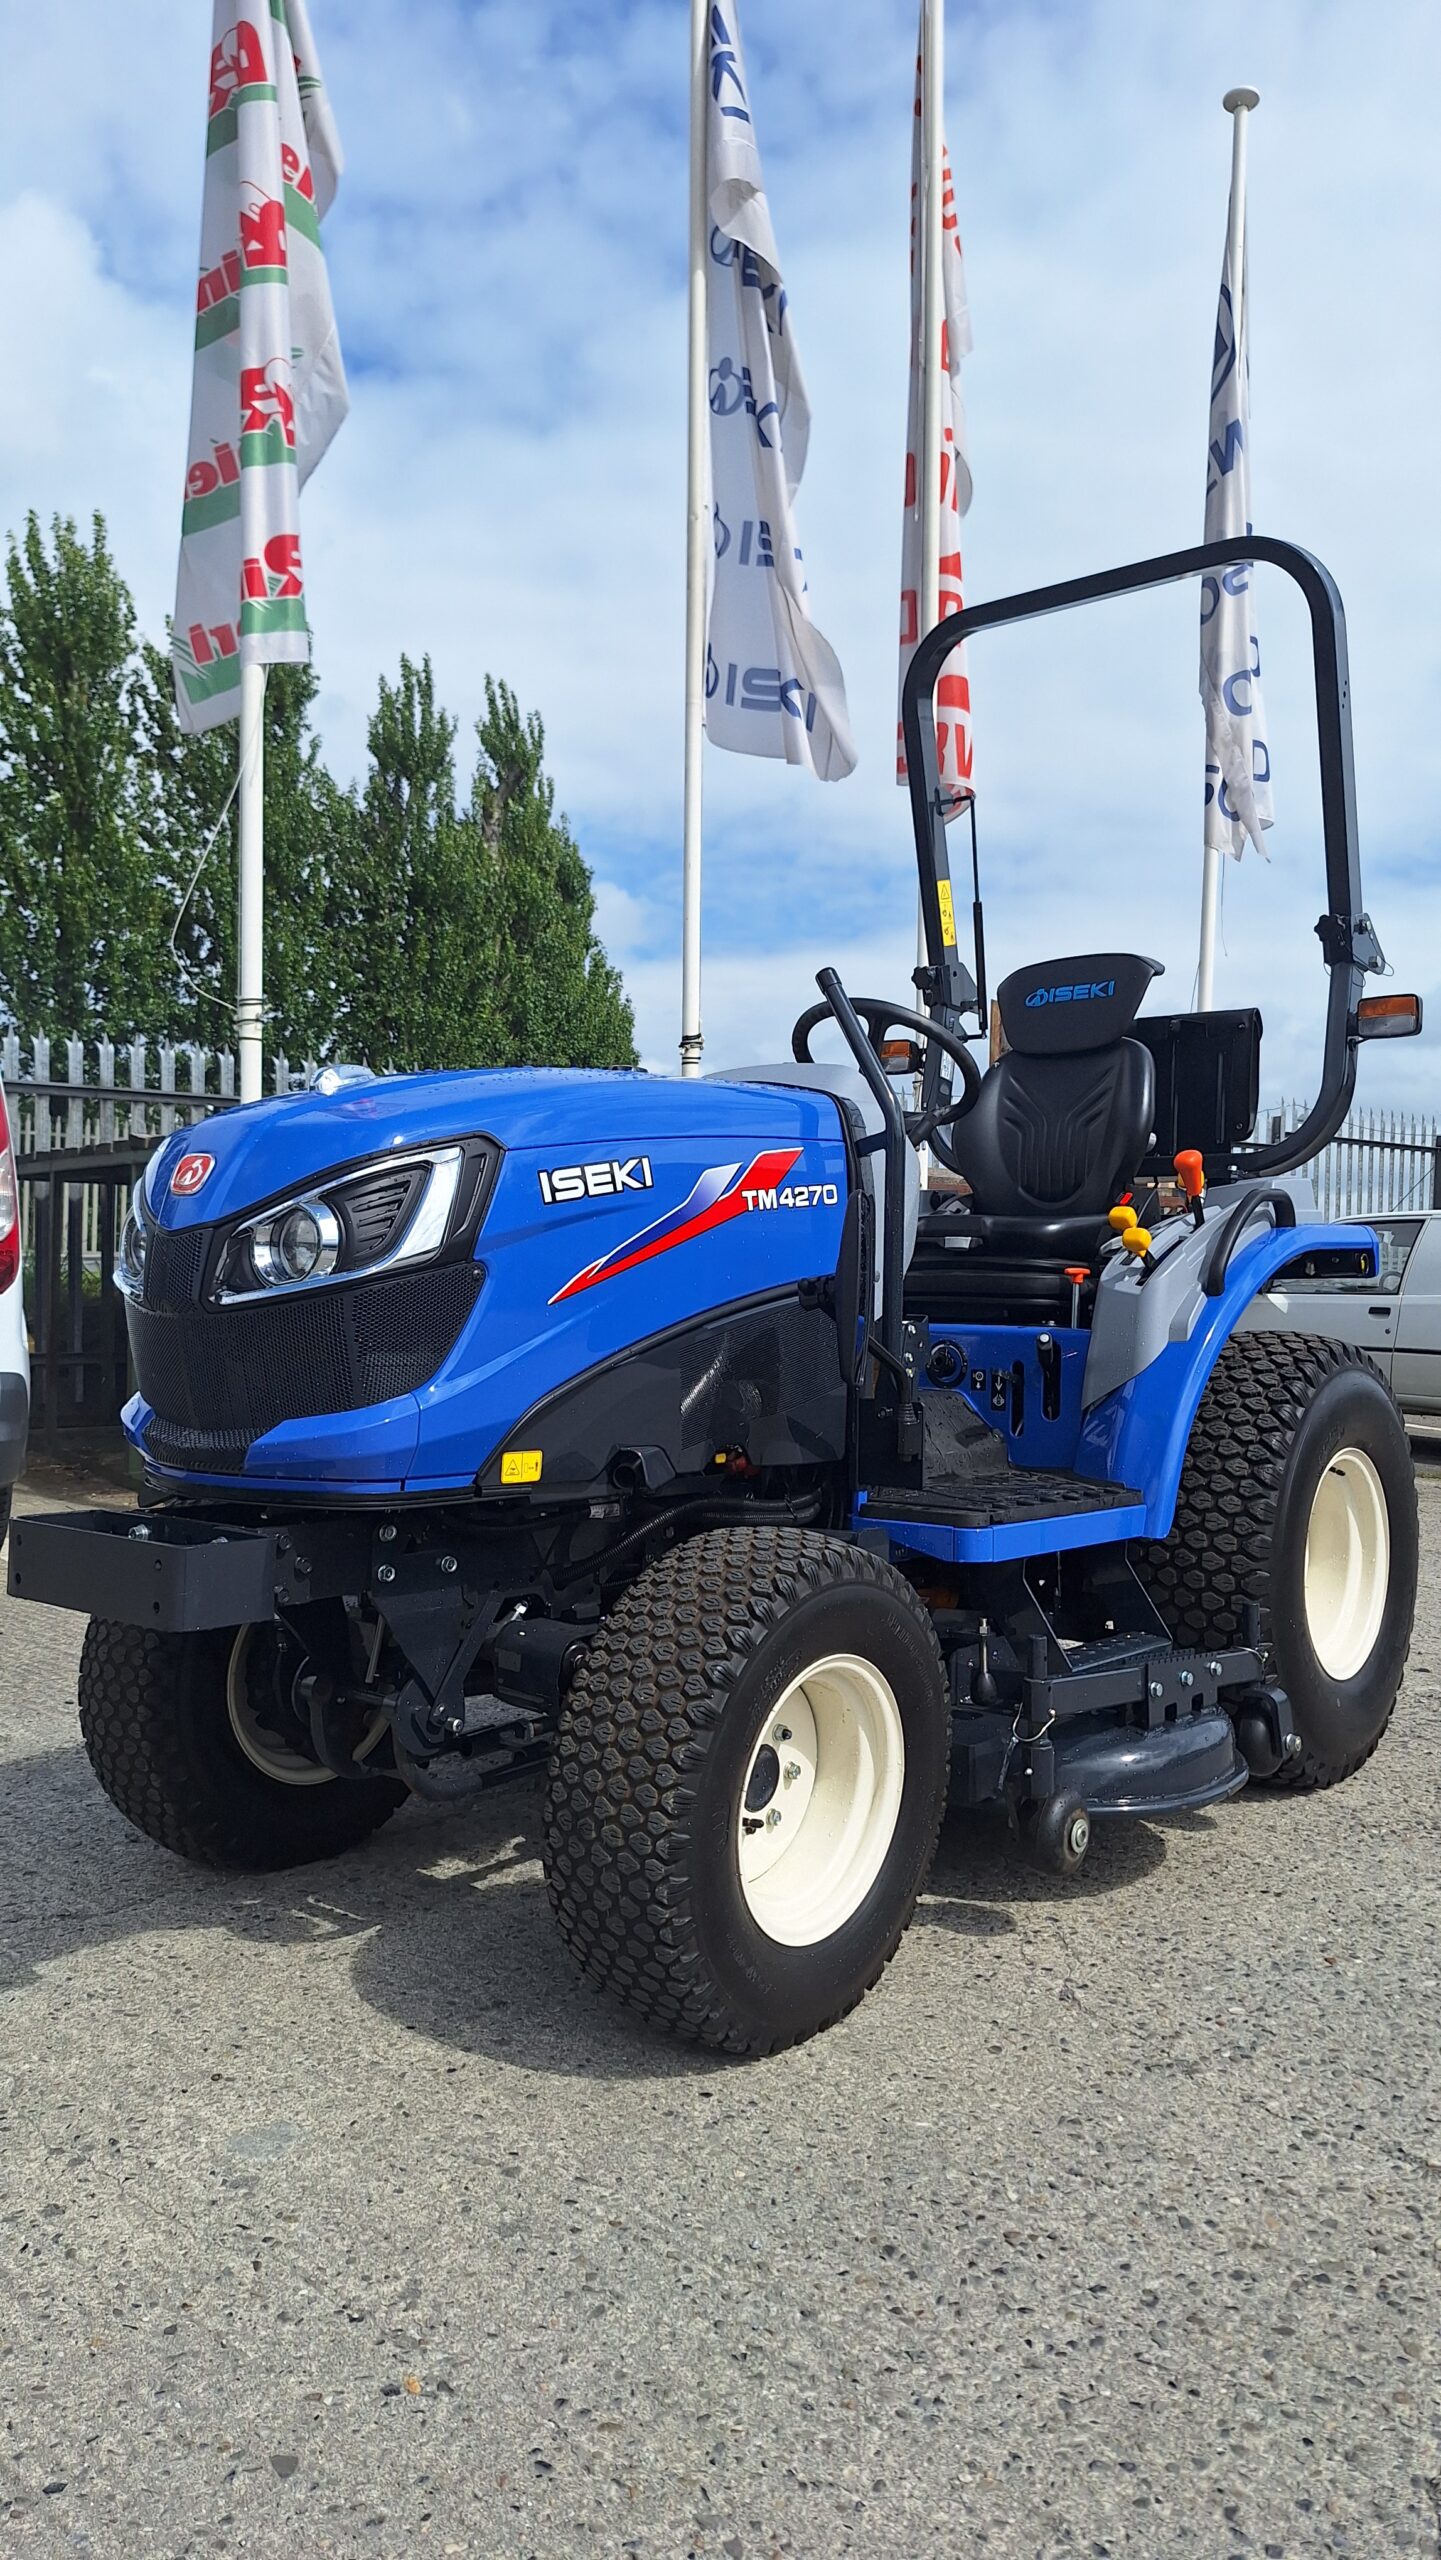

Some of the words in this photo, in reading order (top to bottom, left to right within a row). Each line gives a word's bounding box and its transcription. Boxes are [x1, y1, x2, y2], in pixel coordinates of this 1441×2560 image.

[1048, 980, 1115, 1003] ISEKI
[538, 1155, 654, 1204] ISEKI
[741, 1183, 838, 1211] TM4270
